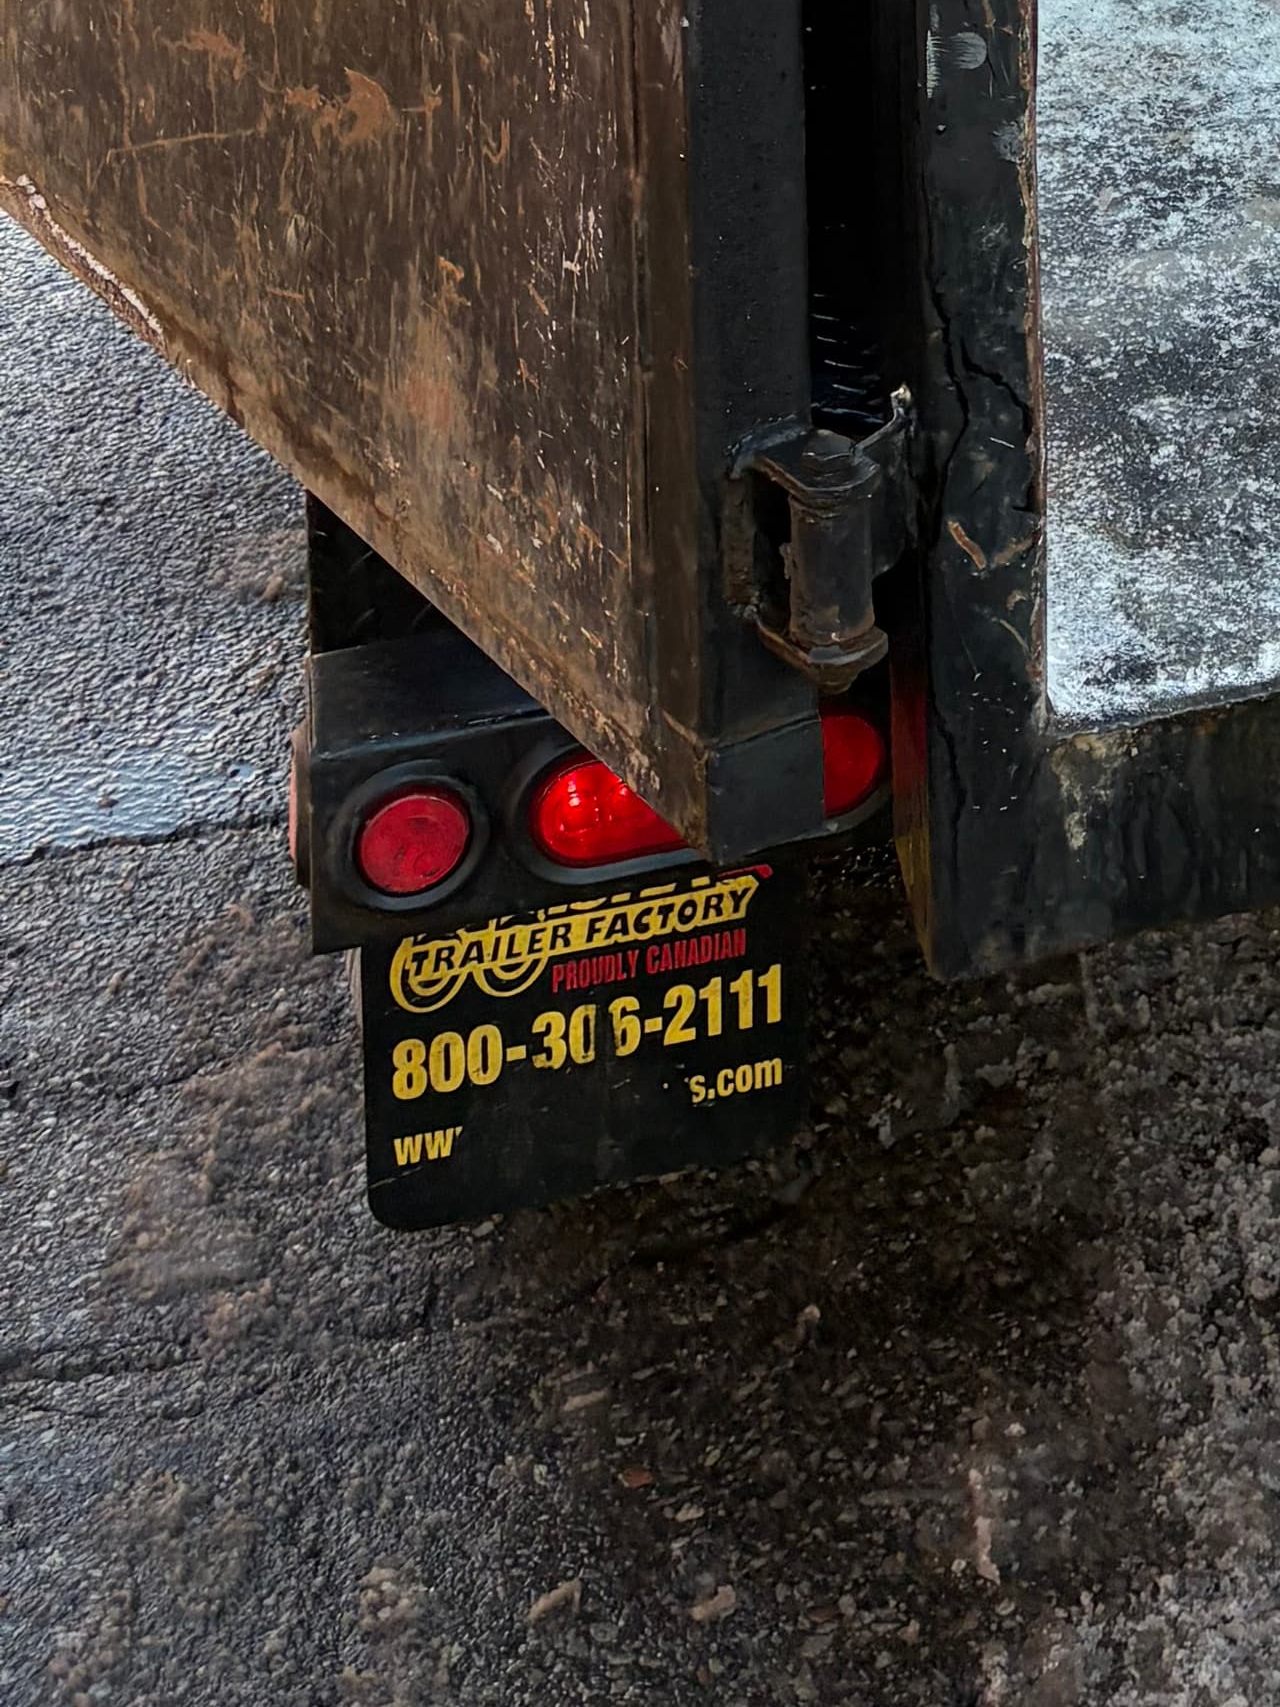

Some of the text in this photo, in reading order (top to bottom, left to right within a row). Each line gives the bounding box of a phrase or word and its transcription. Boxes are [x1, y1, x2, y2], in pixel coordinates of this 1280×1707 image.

[405, 887, 747, 979] TRAILER FACTORY
[551, 928, 747, 993] PROUDLY CANADIAN
[394, 1125, 463, 1167] ww
